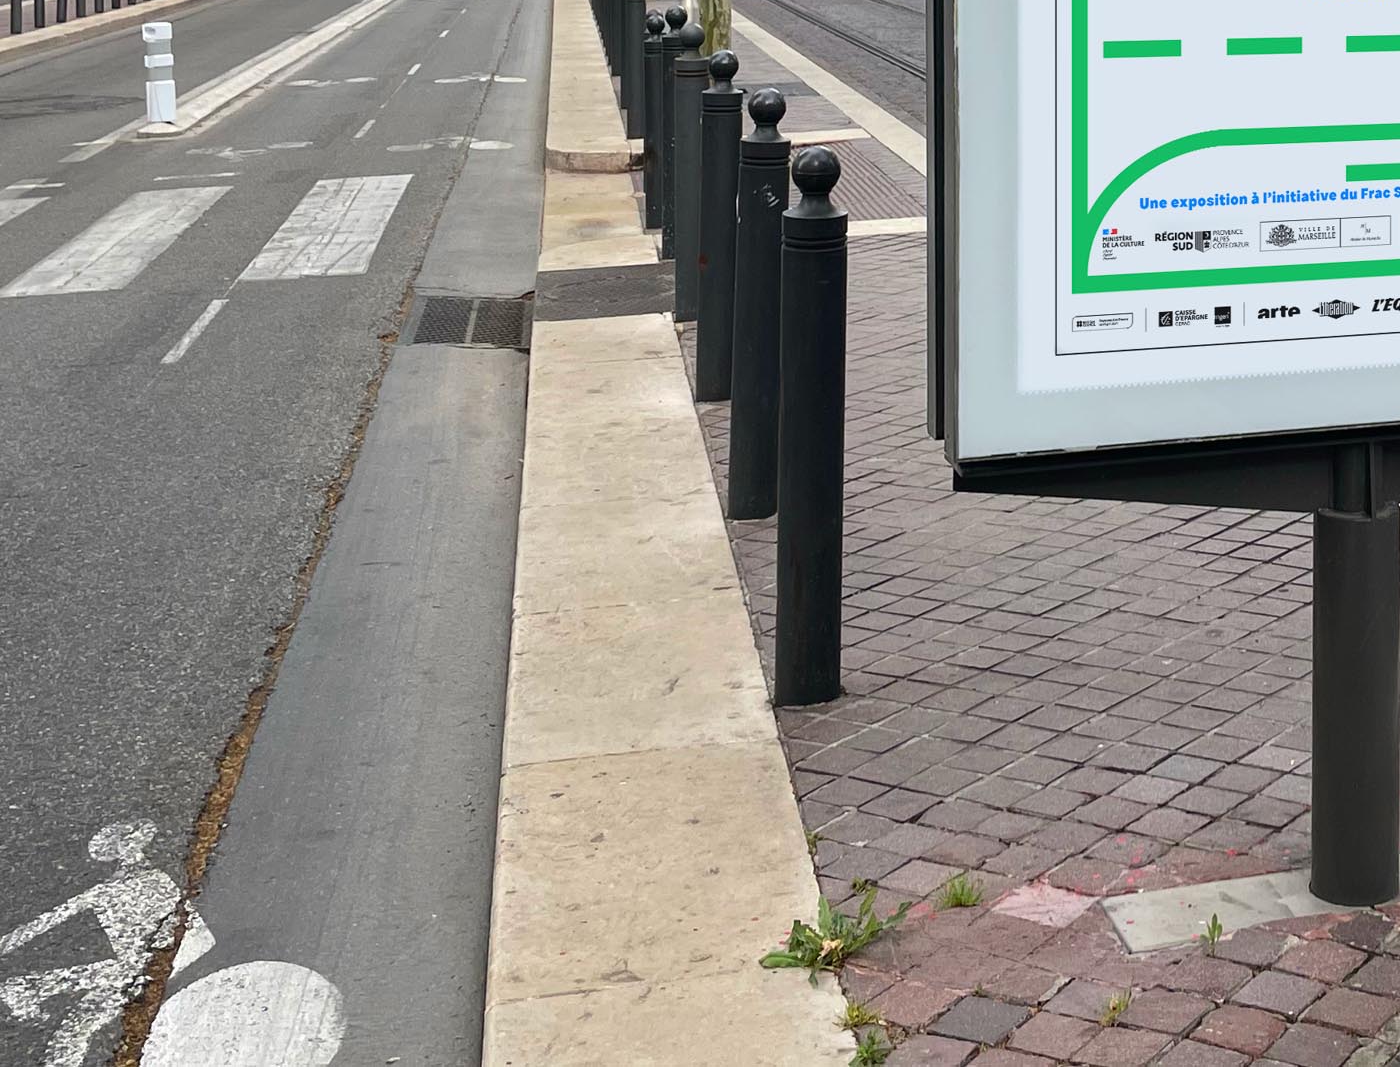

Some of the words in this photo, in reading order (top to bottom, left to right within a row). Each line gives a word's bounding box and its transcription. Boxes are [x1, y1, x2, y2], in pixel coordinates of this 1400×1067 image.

[1140, 198, 1167, 209] Une
[1171, 193, 1247, 210] exposition
[1252, 192, 1259, 204] à
[1263, 189, 1336, 203] l'initiative
[1341, 189, 1357, 200] du
[1361, 188, 1390, 199] Frac
[1155, 232, 1193, 241] RÉGION
[1298, 232, 1336, 240] MARSEILLE
[1173, 242, 1193, 251] SUD
[1258, 306, 1300, 319] arte
